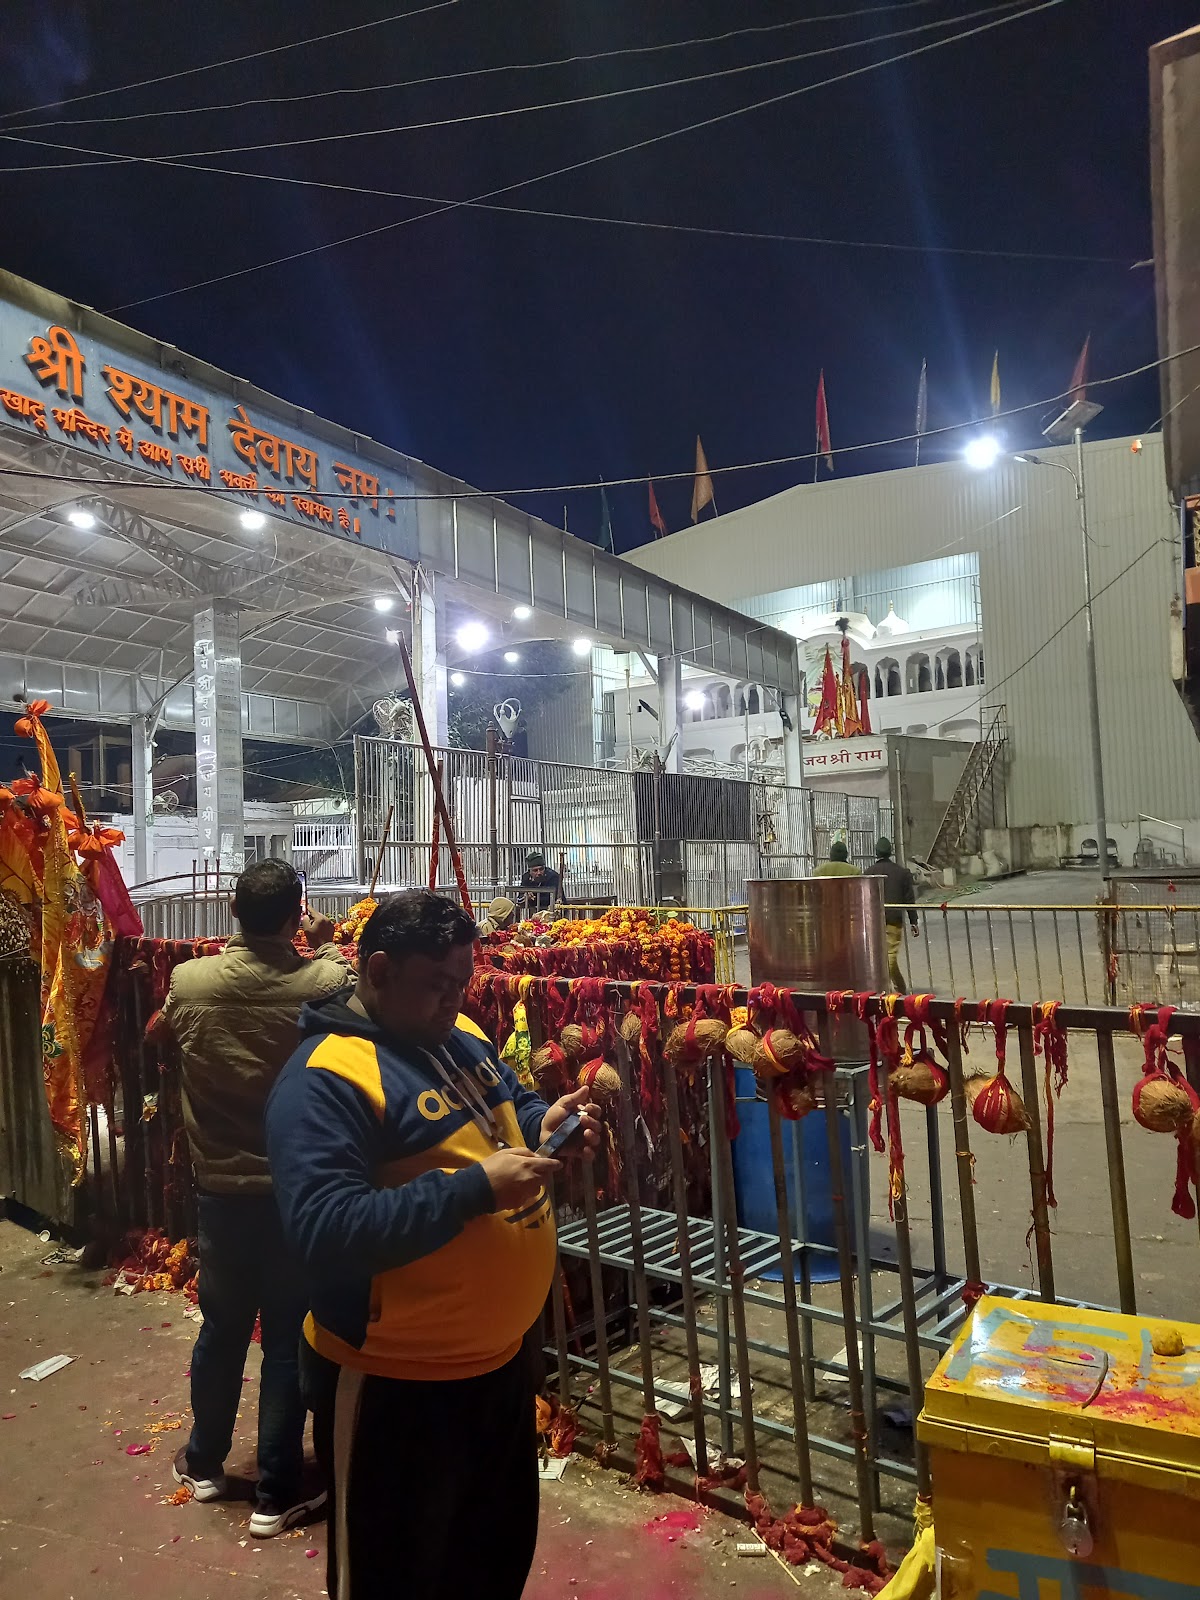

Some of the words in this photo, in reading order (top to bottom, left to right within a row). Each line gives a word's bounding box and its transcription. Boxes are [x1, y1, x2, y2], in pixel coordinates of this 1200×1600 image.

[26, 324, 85, 397] श्री
[103, 364, 209, 445] श्याम
[0, 387, 48, 431] खाटू
[137, 440, 172, 466] आप
[176, 454, 211, 480] सभी
[291, 494, 333, 523] स्वागत
[803, 755, 828, 767] जय
[830, 749, 852, 765] श्री
[854, 749, 883, 762] राम
[202, 805, 214, 822] श्री
